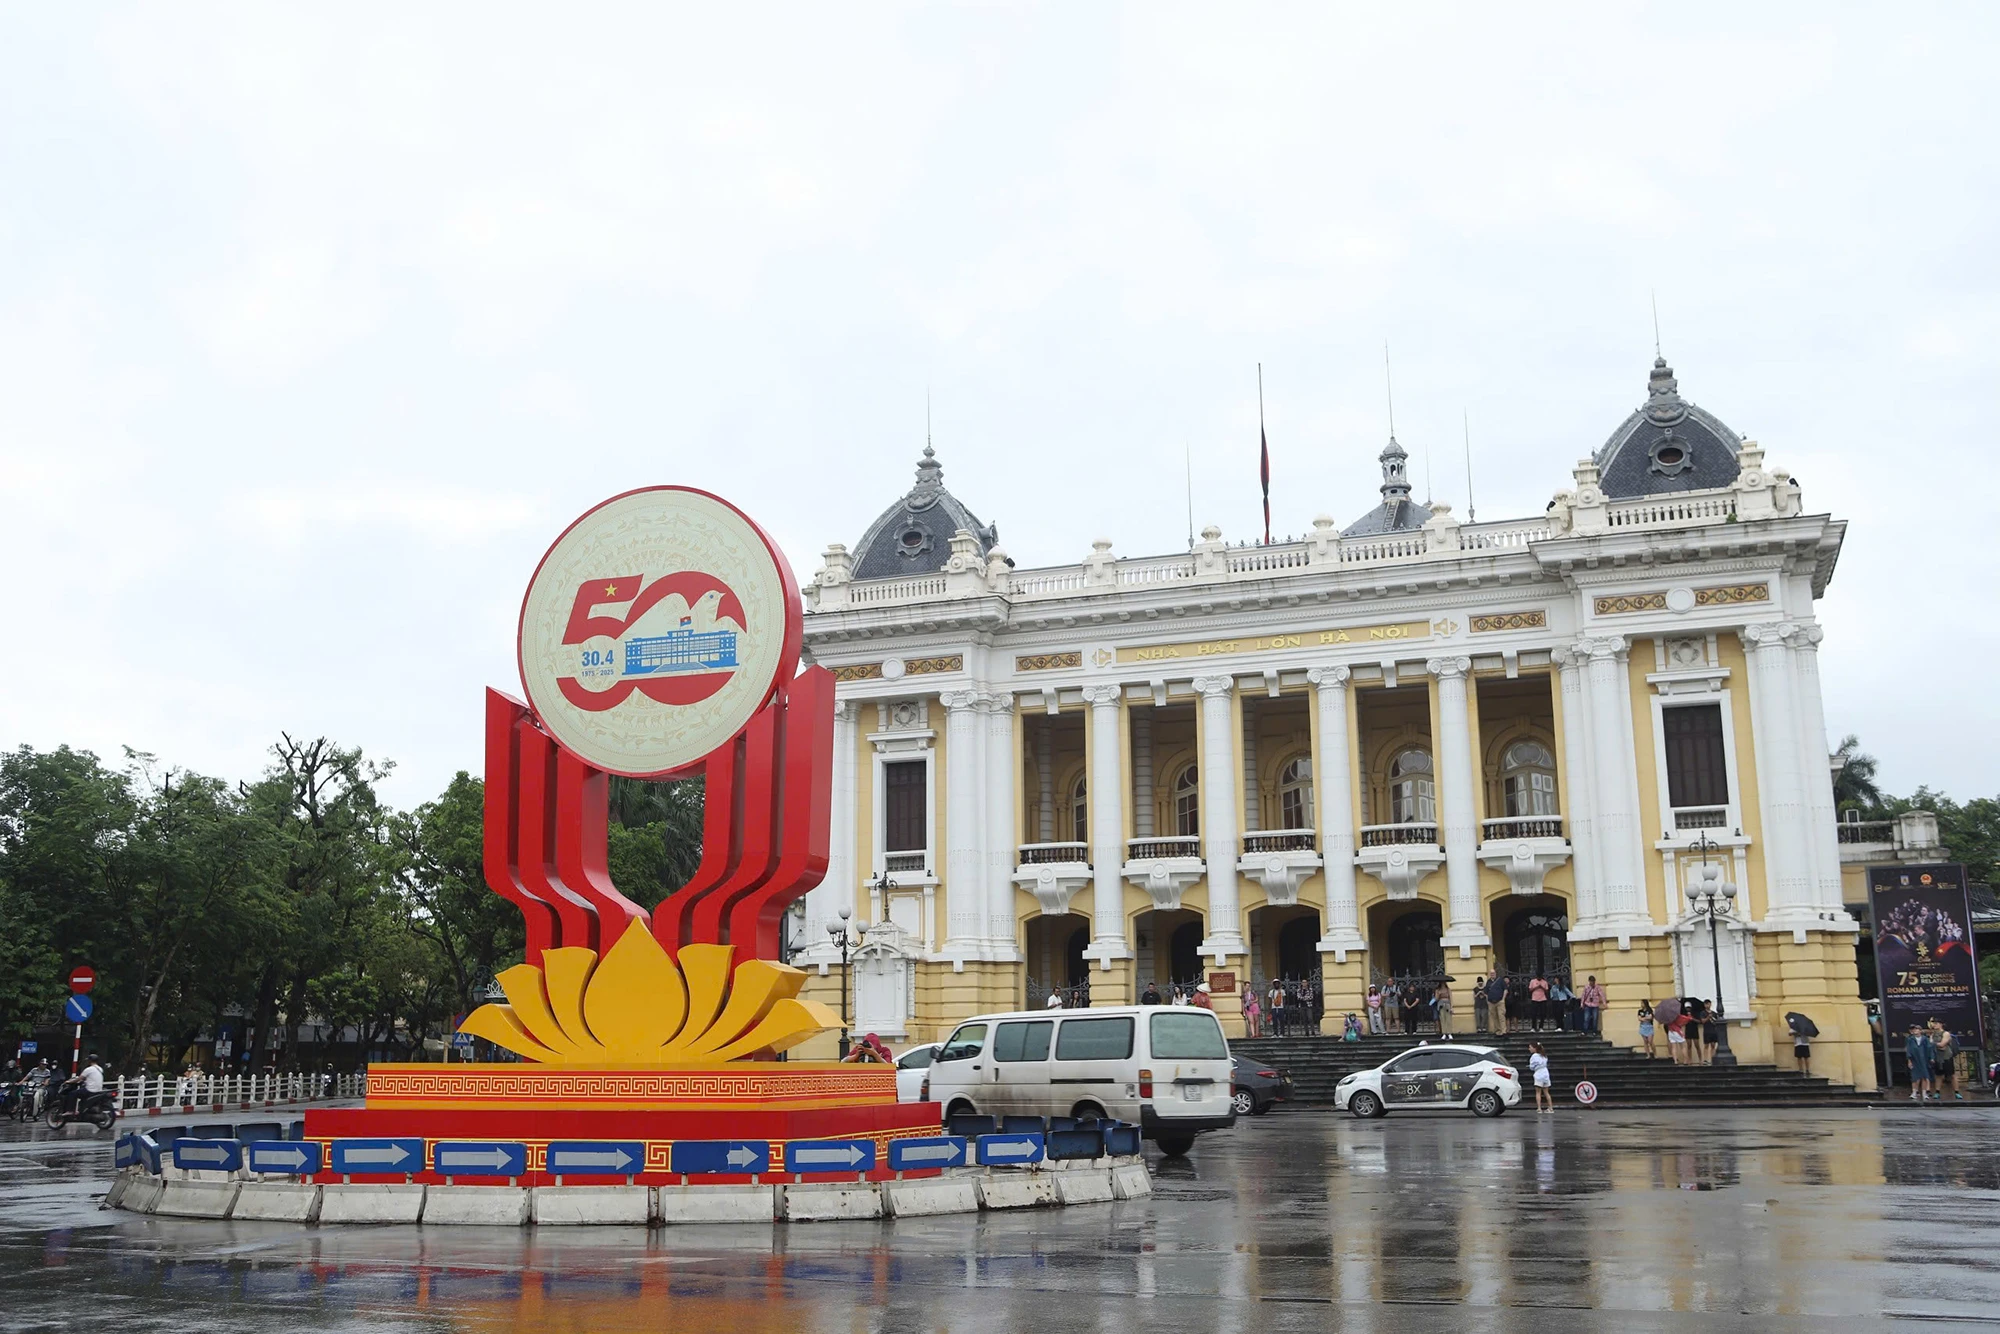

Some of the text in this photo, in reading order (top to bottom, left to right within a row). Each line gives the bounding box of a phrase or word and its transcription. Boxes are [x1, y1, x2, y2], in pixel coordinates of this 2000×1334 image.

[1136, 624, 1409, 661] NHÀ HÁT LỚN HÀ NỘI
[581, 649, 614, 666] 30.4
[1897, 972, 1919, 986] 75
[1407, 1084, 1421, 1094] 8X
